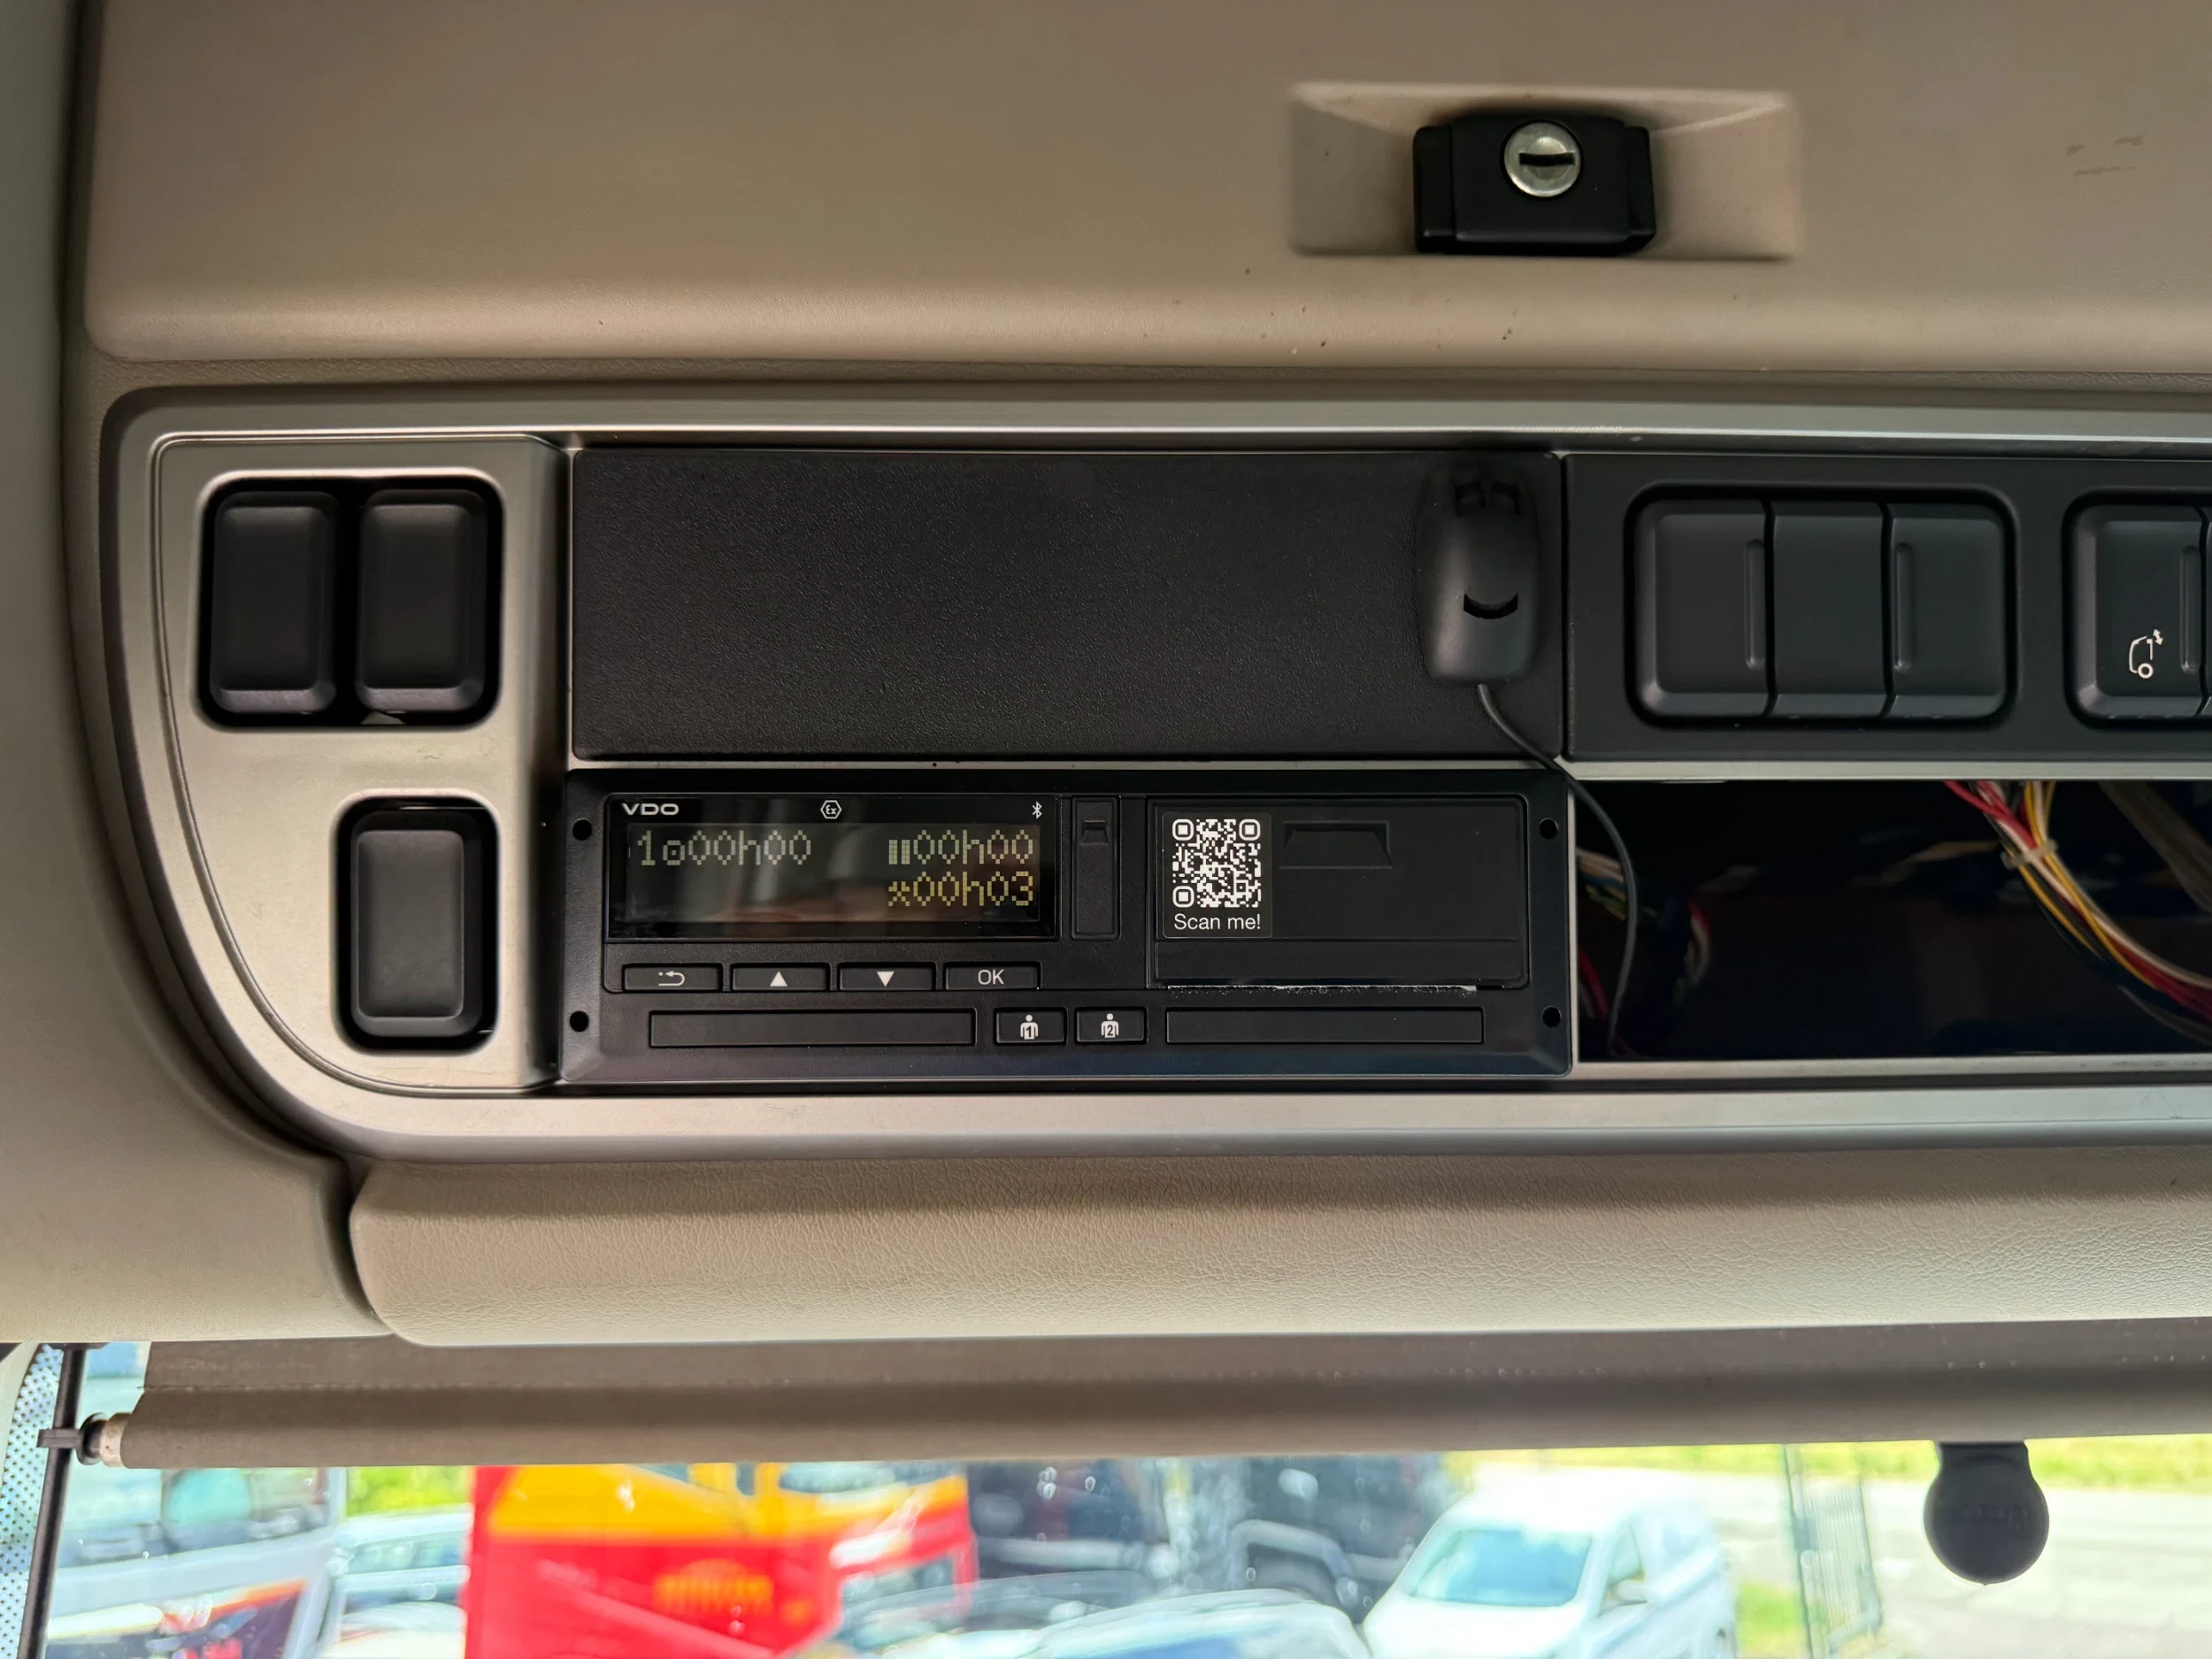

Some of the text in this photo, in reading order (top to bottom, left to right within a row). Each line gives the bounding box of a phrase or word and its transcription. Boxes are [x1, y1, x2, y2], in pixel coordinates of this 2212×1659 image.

[622, 803, 680, 816] VDO
[1173, 913, 1261, 930] Scan me!
[978, 969, 1004, 985] OK
